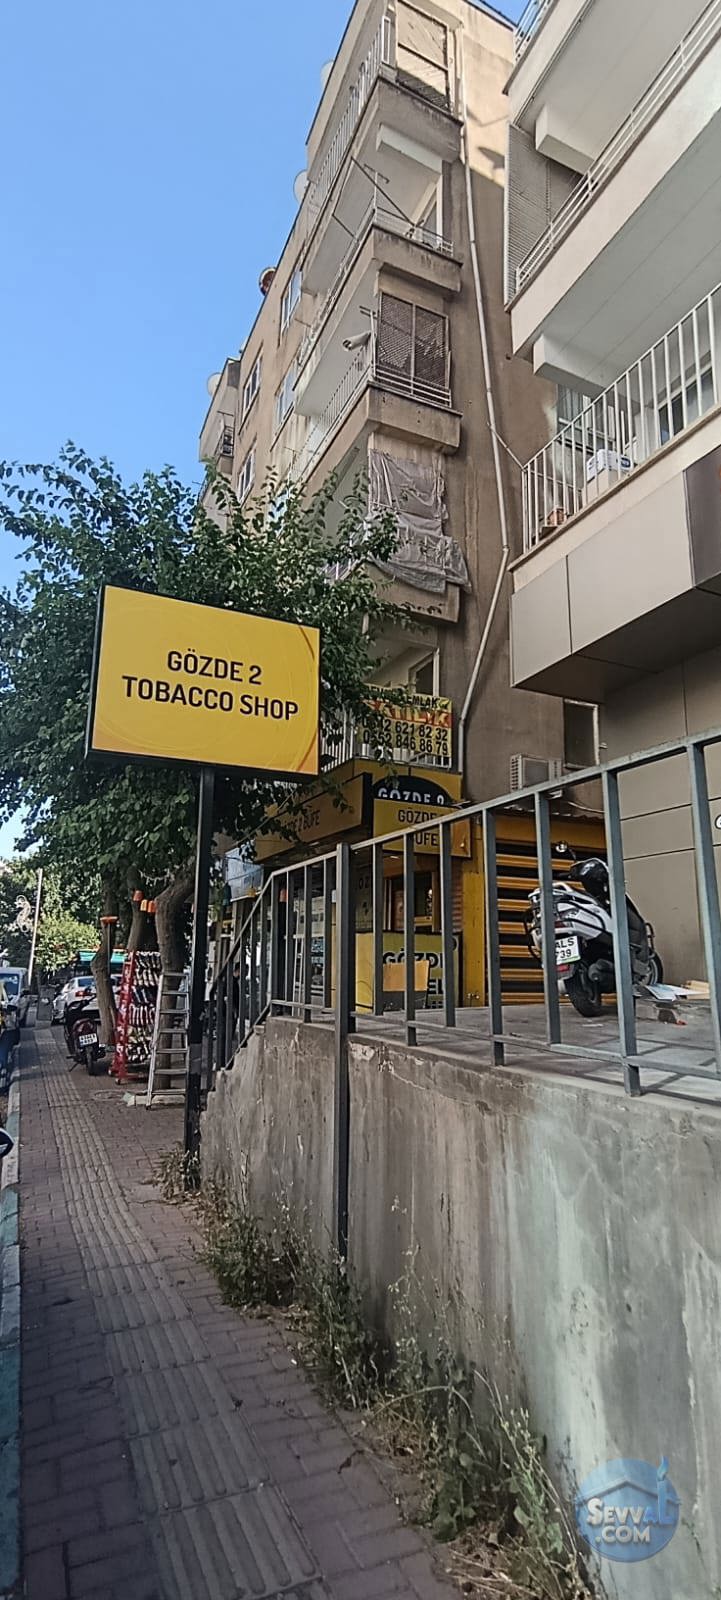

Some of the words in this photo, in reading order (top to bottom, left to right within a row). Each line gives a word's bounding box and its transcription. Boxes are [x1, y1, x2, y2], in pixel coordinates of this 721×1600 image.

[168, 648, 243, 682] GÖZDE
[249, 665, 262, 685] 2
[122, 675, 234, 712] TOBACCO
[240, 694, 299, 721] SHOP
[395, 721, 415, 736] 621
[419, 725, 432, 739] 82
[436, 728, 448, 741] 32
[396, 734, 416, 750] 846
[419, 739, 433, 753] 86
[436, 742, 448, 756] 79
